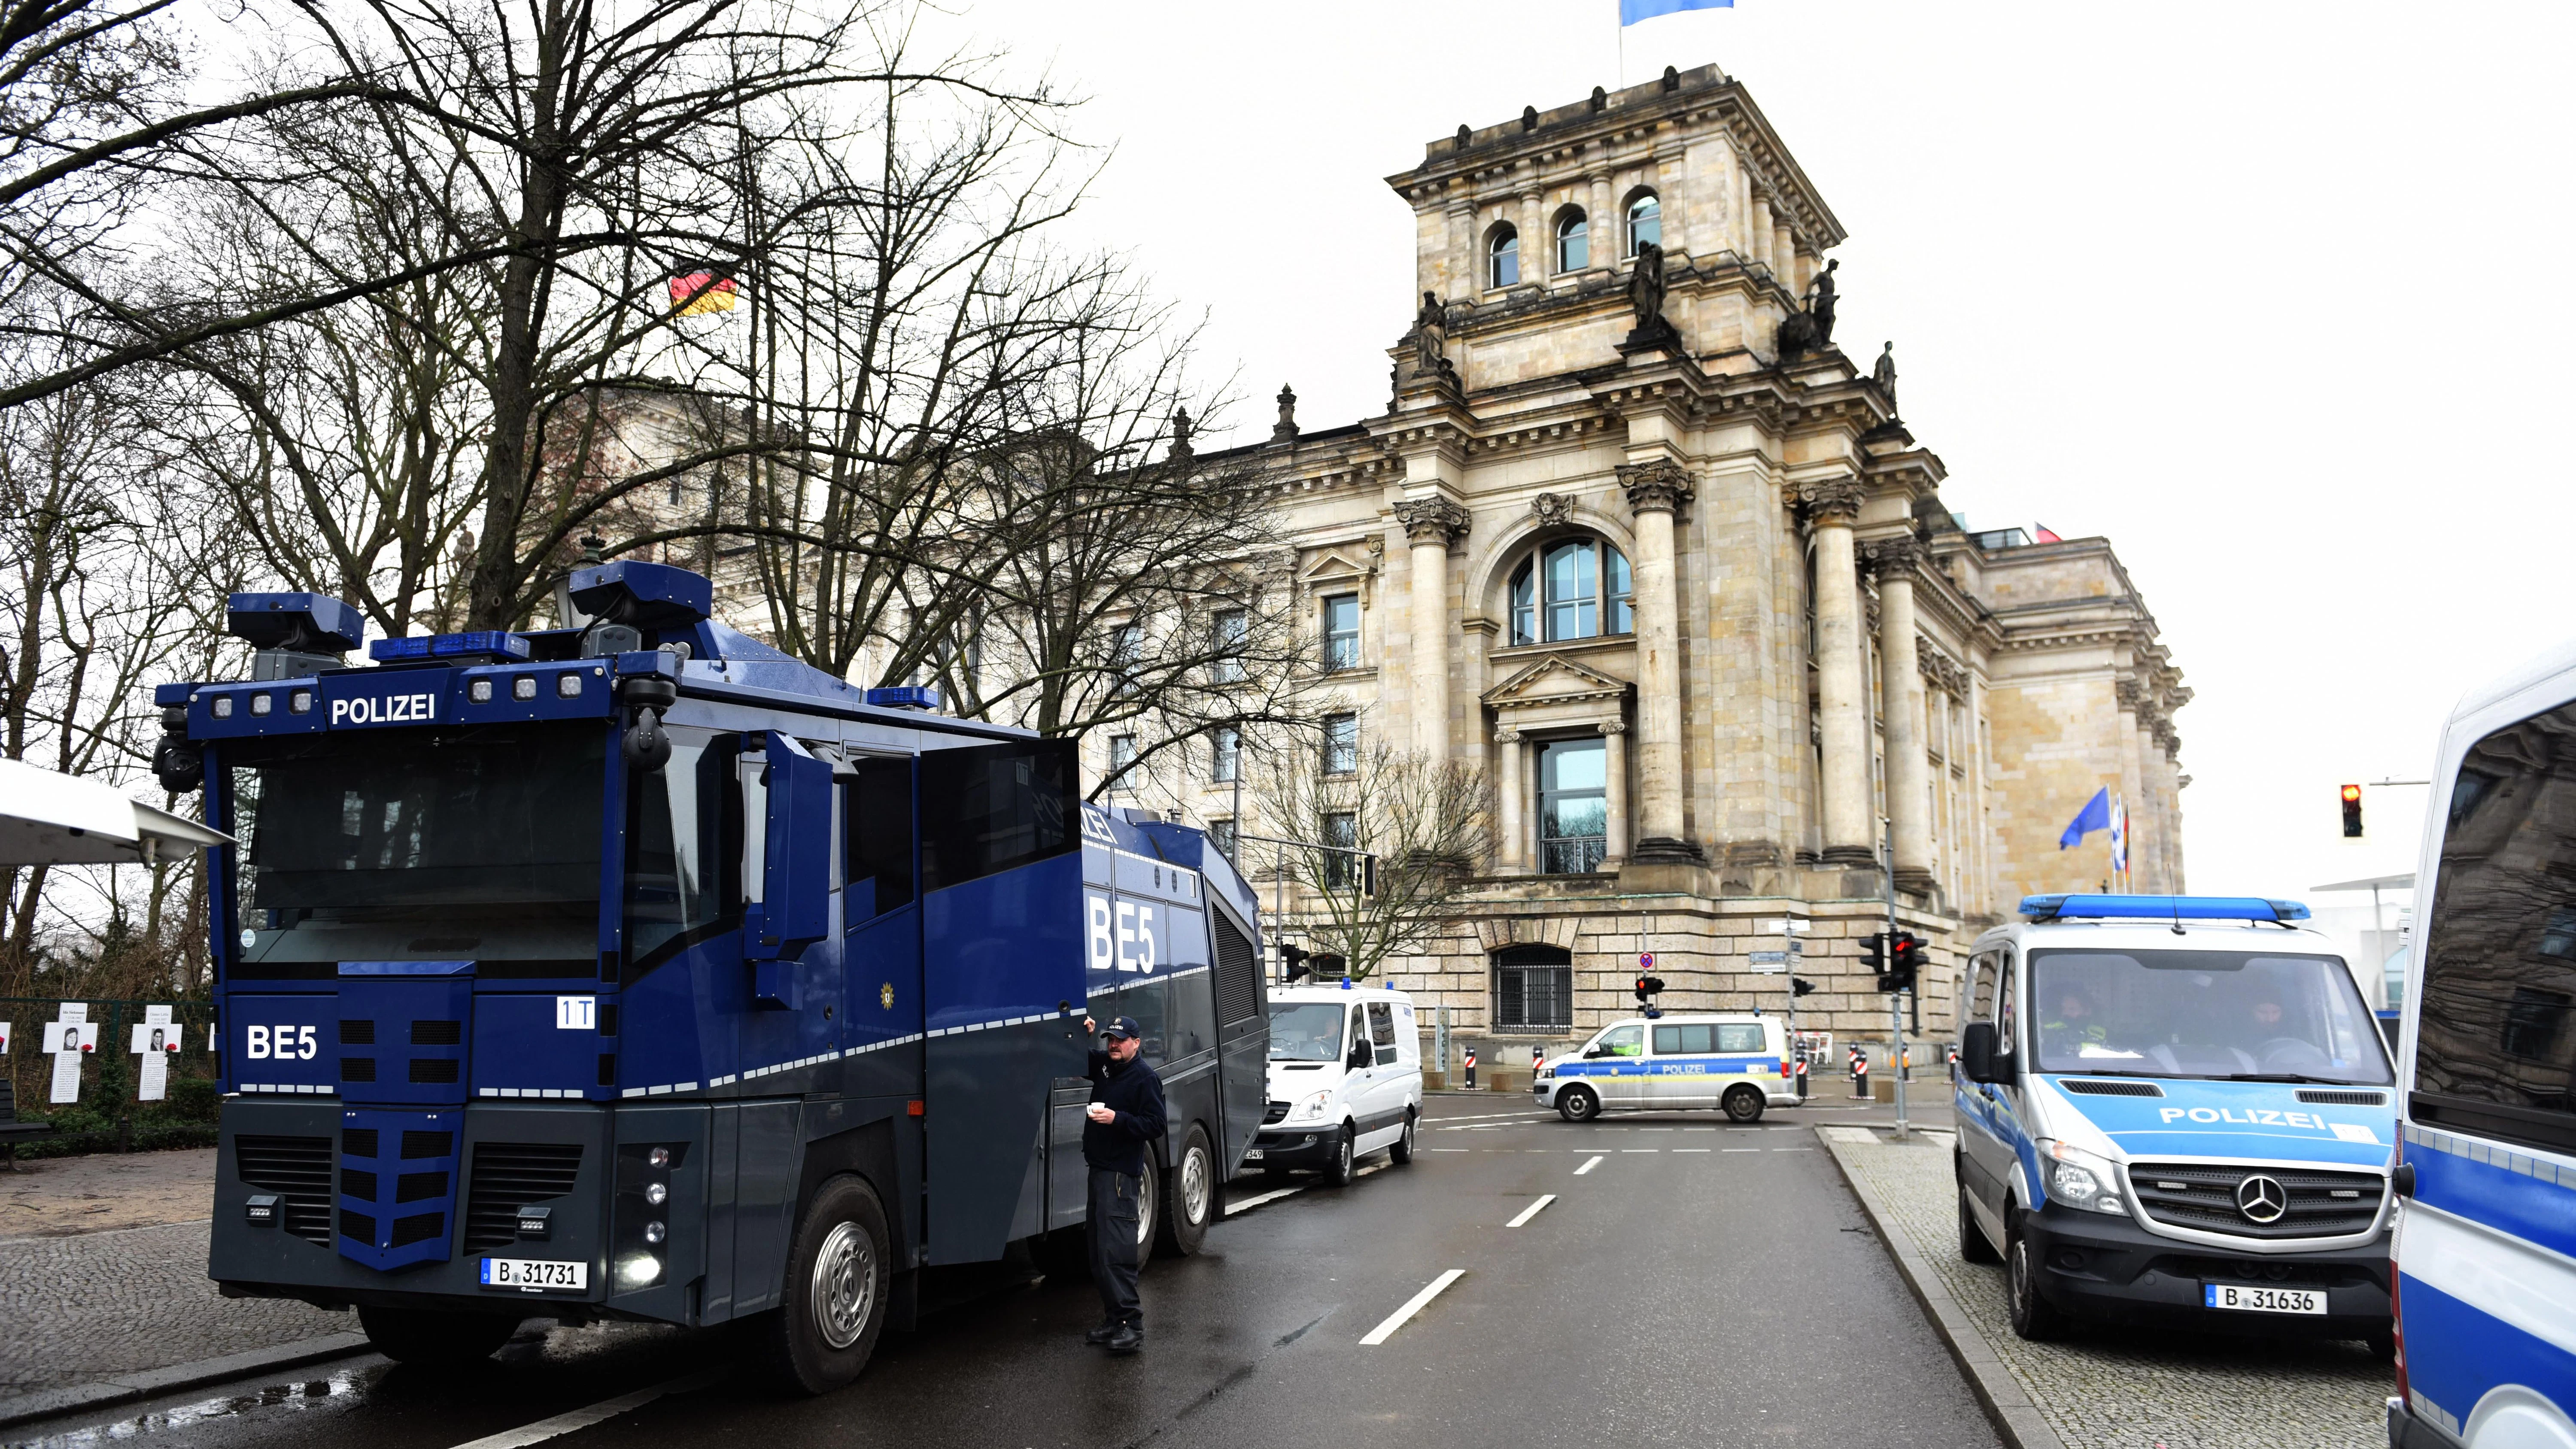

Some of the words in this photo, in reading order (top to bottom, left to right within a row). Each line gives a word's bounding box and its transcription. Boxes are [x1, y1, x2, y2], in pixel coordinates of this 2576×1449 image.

[332, 693, 434, 725] POLIZEI
[1089, 896, 1155, 974] BE5
[563, 1000, 592, 1025] 1T
[248, 1025, 317, 1060] BE5
[1662, 1064, 1705, 1075] POLIZEI
[2159, 1107, 2326, 1130] POLIZEI
[500, 1262, 510, 1282] B
[523, 1263, 576, 1285] 31731
[2226, 1288, 2238, 1306] B
[2253, 1290, 2314, 1311] 31636
